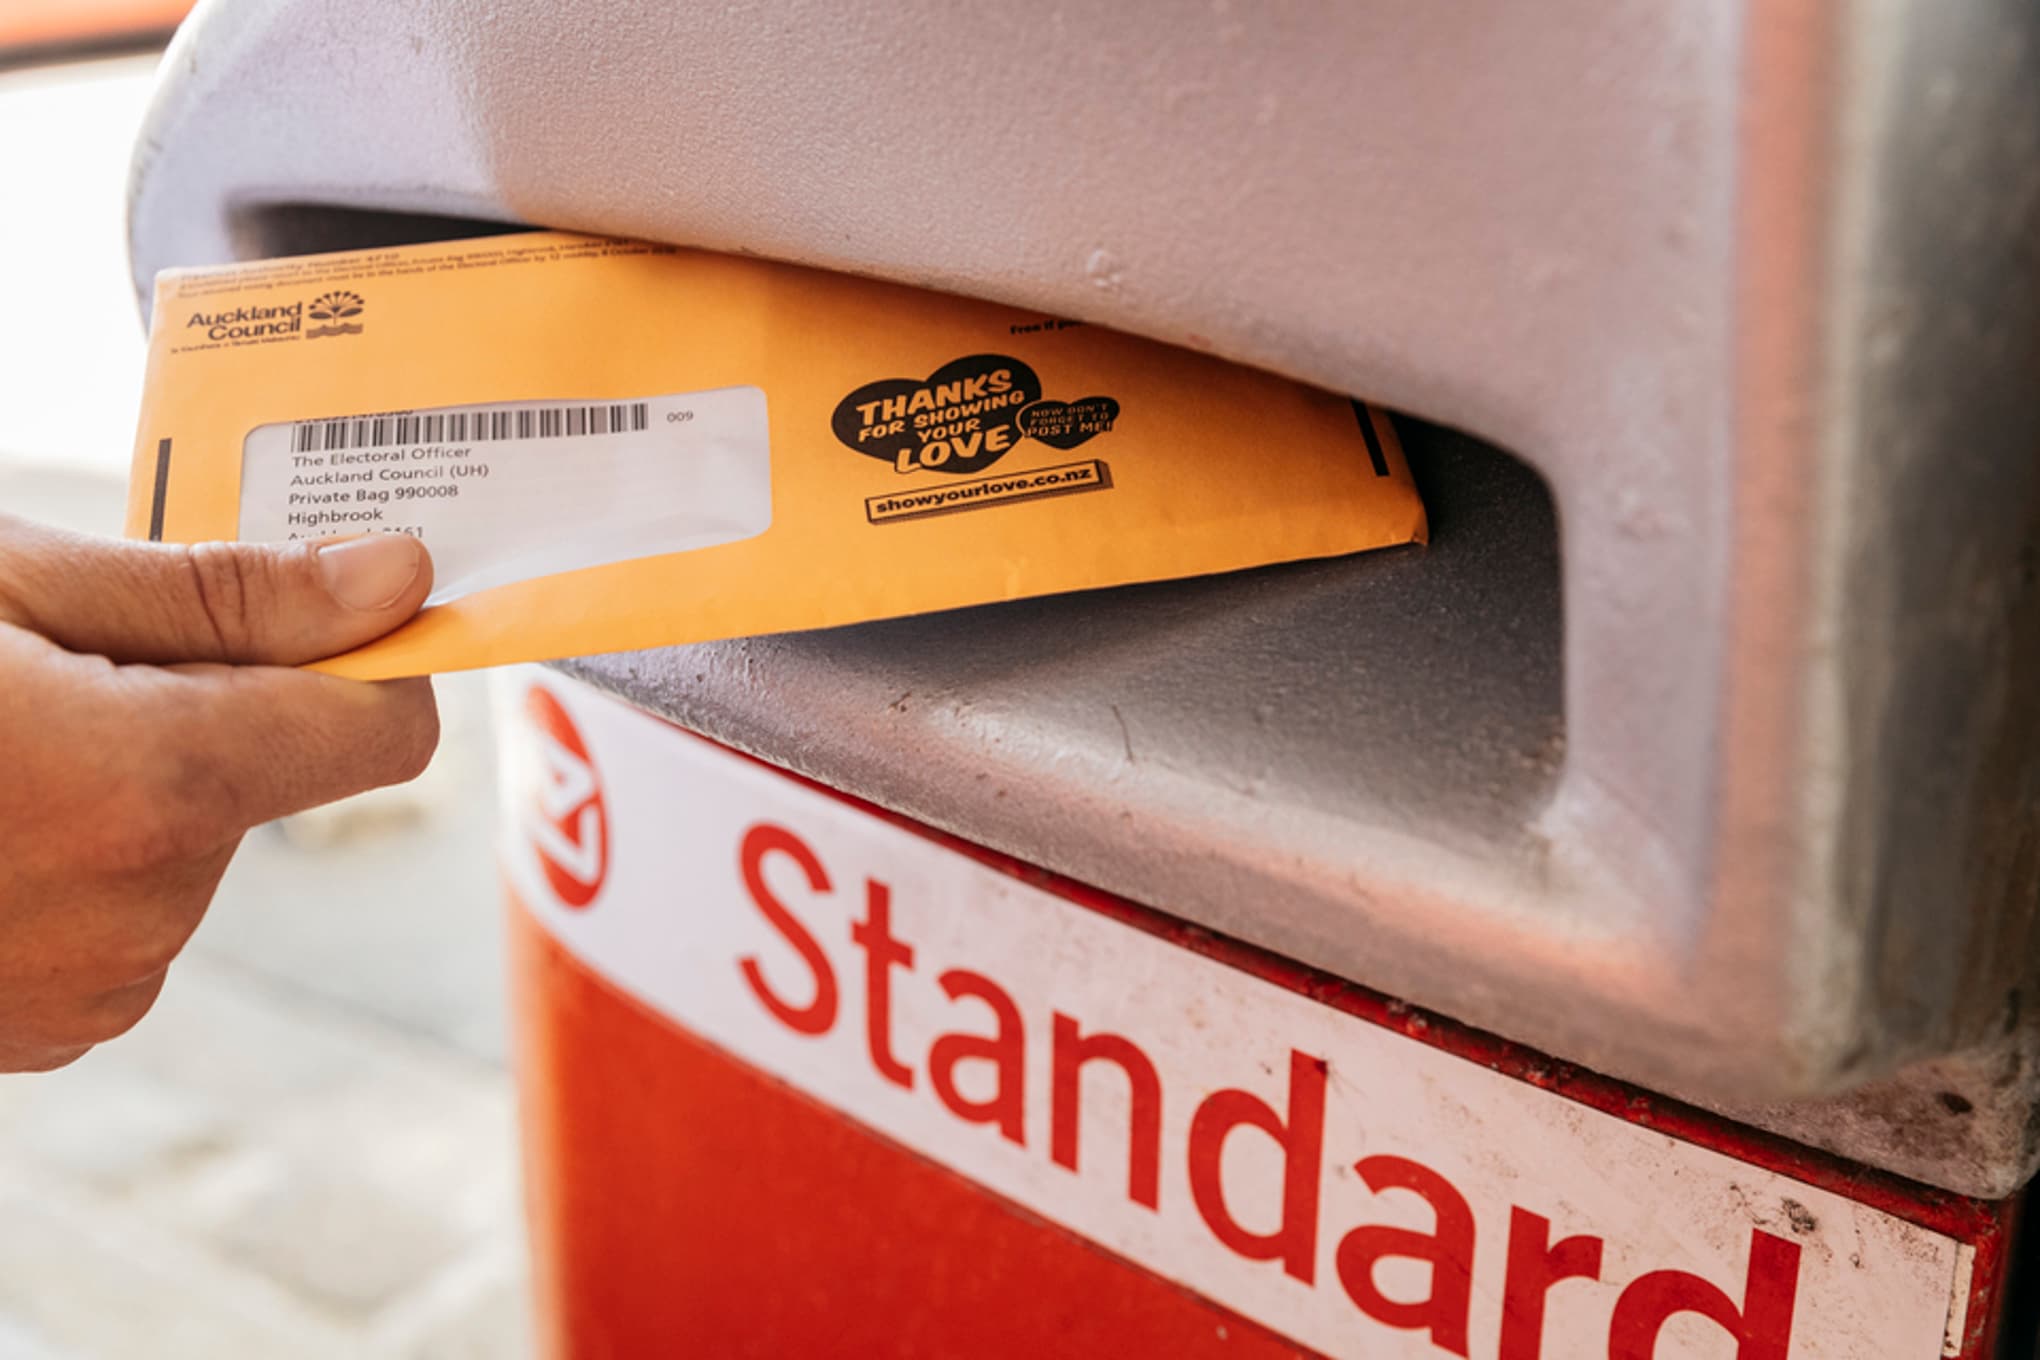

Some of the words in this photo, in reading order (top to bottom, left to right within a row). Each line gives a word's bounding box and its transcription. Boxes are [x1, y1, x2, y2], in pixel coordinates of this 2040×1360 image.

[187, 301, 302, 329] Auckland
[208, 317, 301, 341] Council
[856, 369, 1013, 426] THANKS
[666, 410, 695, 423] 009
[858, 420, 906, 443] FOR
[913, 390, 1025, 429] SHOWING
[1026, 424, 1073, 437] POST
[1080, 420, 1113, 433] ME!
[917, 418, 982, 444] YOUR
[292, 455, 324, 468] The
[330, 448, 405, 466] Electoral
[411, 446, 472, 461] Officer
[896, 424, 1012, 474] LOVE
[290, 470, 373, 487] Auckland
[379, 465, 444, 482] Council
[449, 463, 490, 480] (UH)
[288, 490, 351, 505] Private
[356, 488, 390, 505] Bag
[395, 484, 459, 500] 990008
[876, 469, 1093, 514] showyourlove.co.nz
[288, 508, 383, 527] Highbrook
